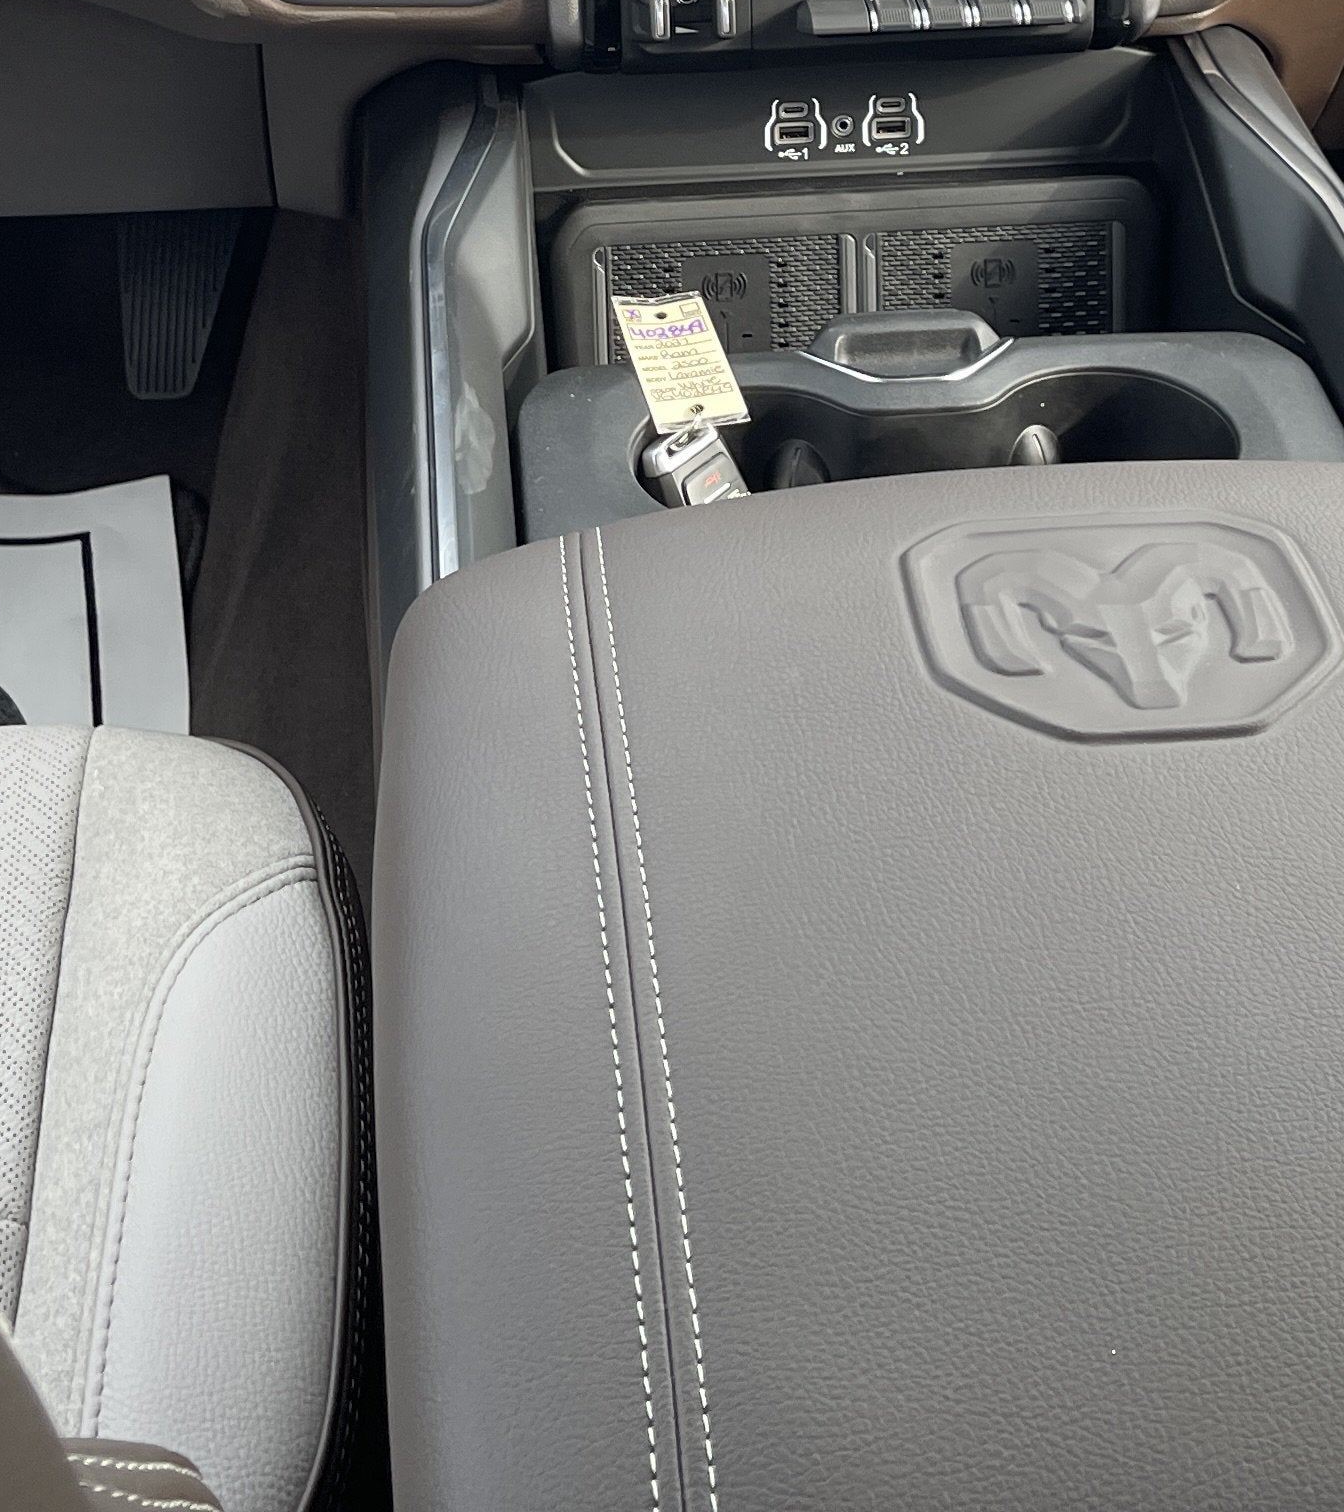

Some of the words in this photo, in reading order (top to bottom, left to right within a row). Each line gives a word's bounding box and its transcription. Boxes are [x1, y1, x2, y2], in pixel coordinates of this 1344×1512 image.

[802, 148, 809, 160] 1
[834, 144, 856, 153] AUX
[899, 143, 909, 155] 2
